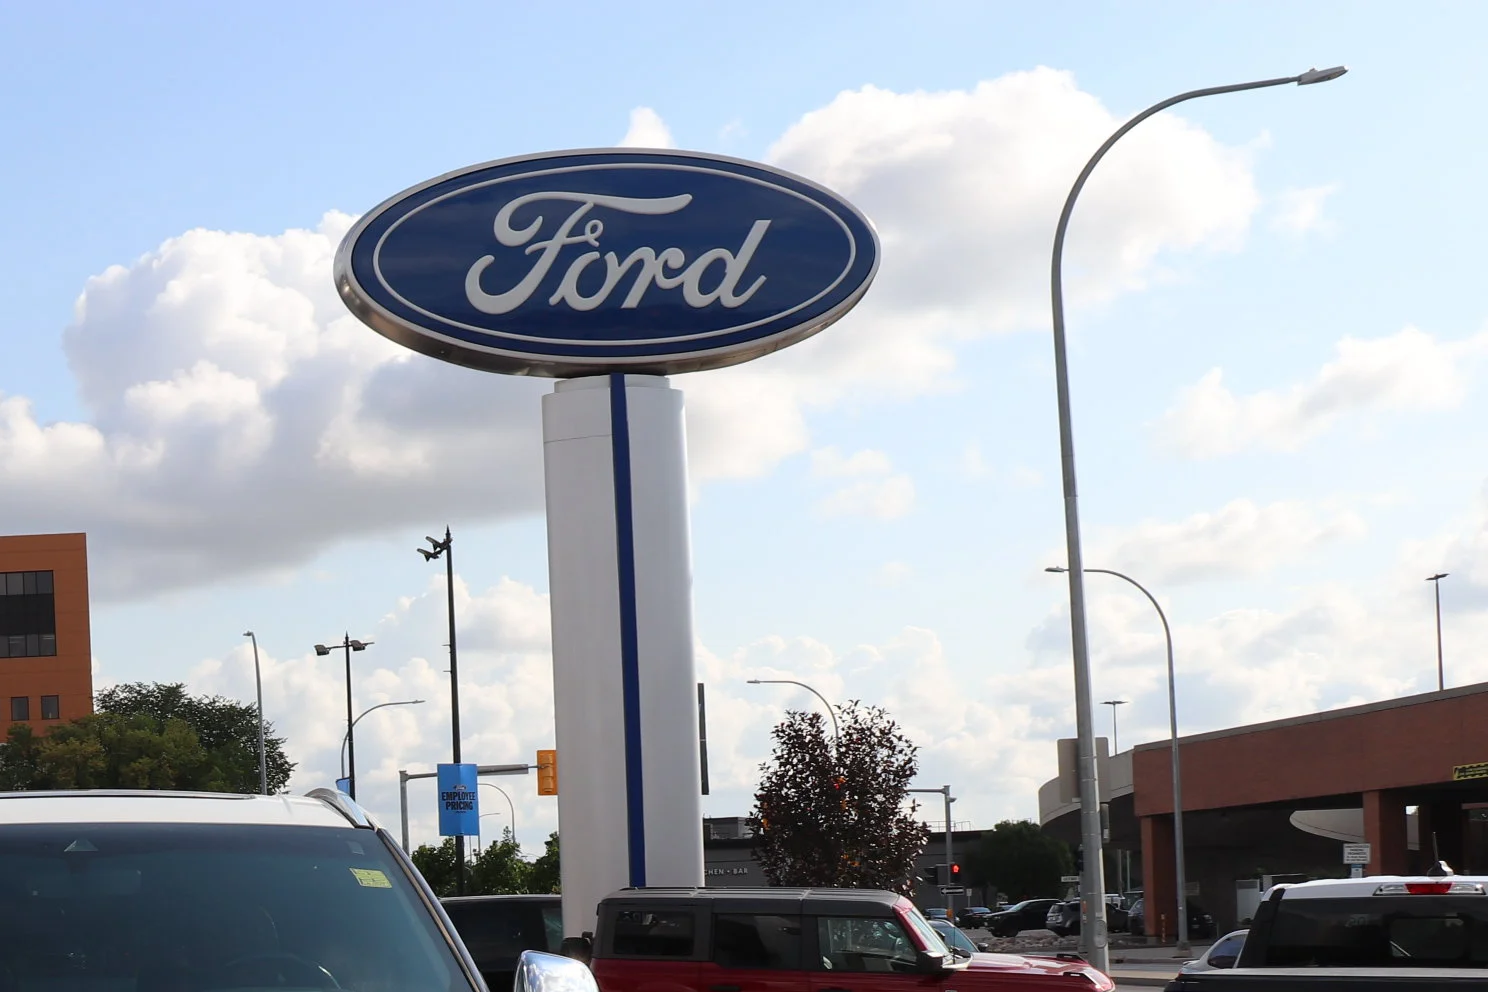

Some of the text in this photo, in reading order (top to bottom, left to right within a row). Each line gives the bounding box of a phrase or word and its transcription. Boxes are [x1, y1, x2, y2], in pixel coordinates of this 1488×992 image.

[464, 190, 772, 315] Ford
[442, 791, 476, 801] EMPLOYEE
[445, 800, 474, 811] PRICING
